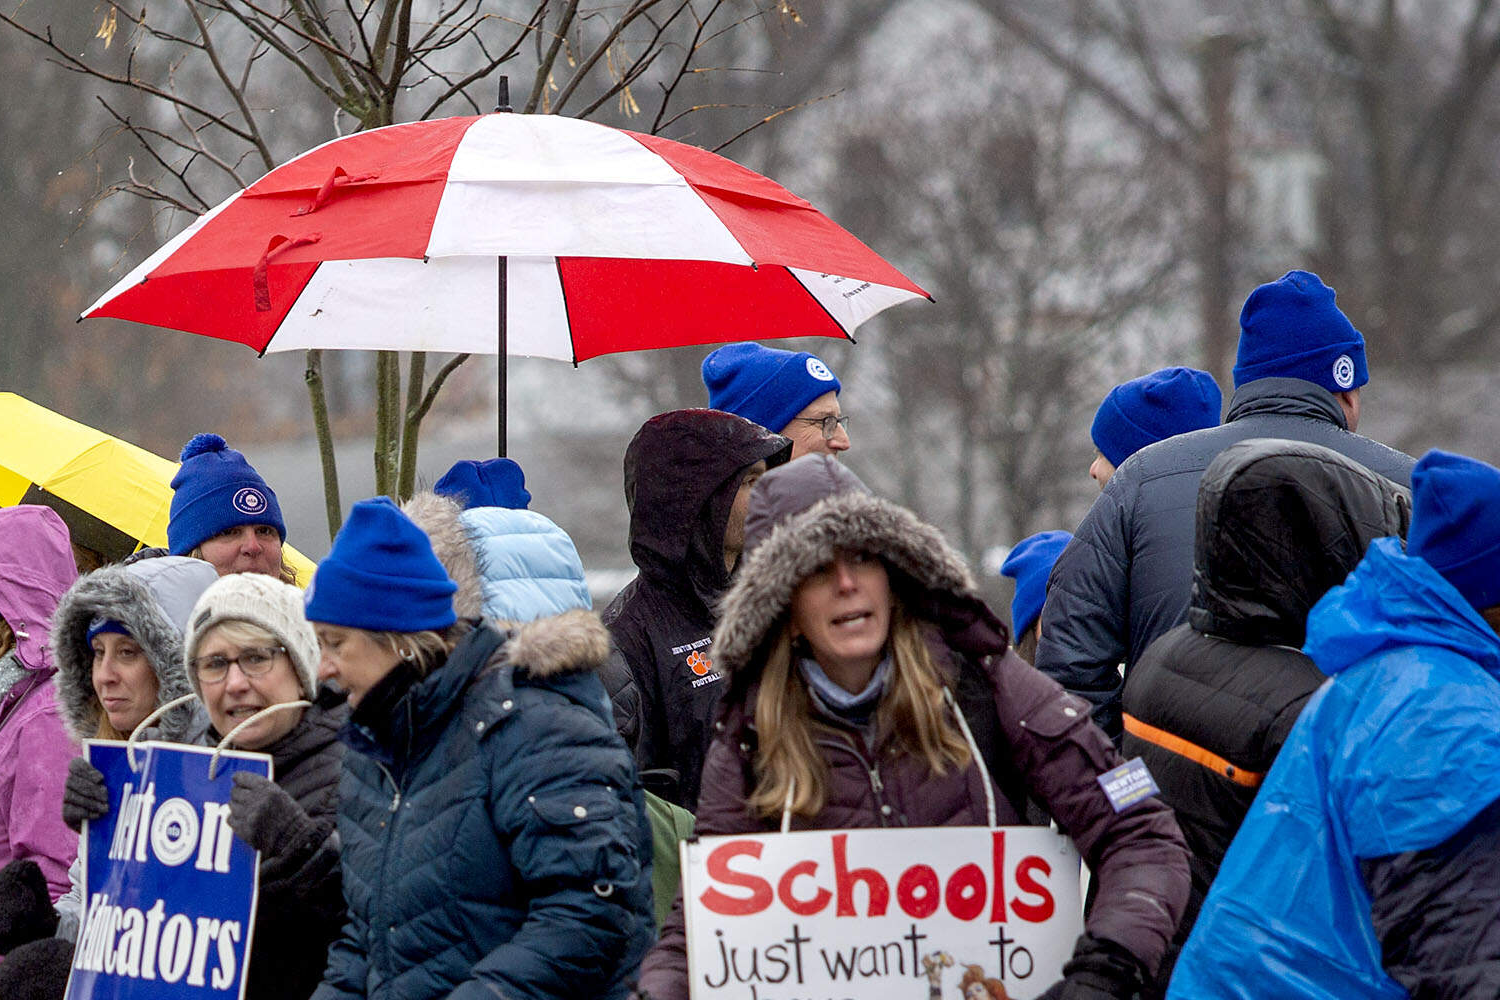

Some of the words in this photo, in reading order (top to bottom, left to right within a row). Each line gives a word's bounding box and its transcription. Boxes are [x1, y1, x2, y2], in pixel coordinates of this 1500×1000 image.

[699, 831, 1056, 923] Schools
[704, 924, 812, 988] just
[821, 924, 928, 980] want
[990, 925, 1034, 980] to
